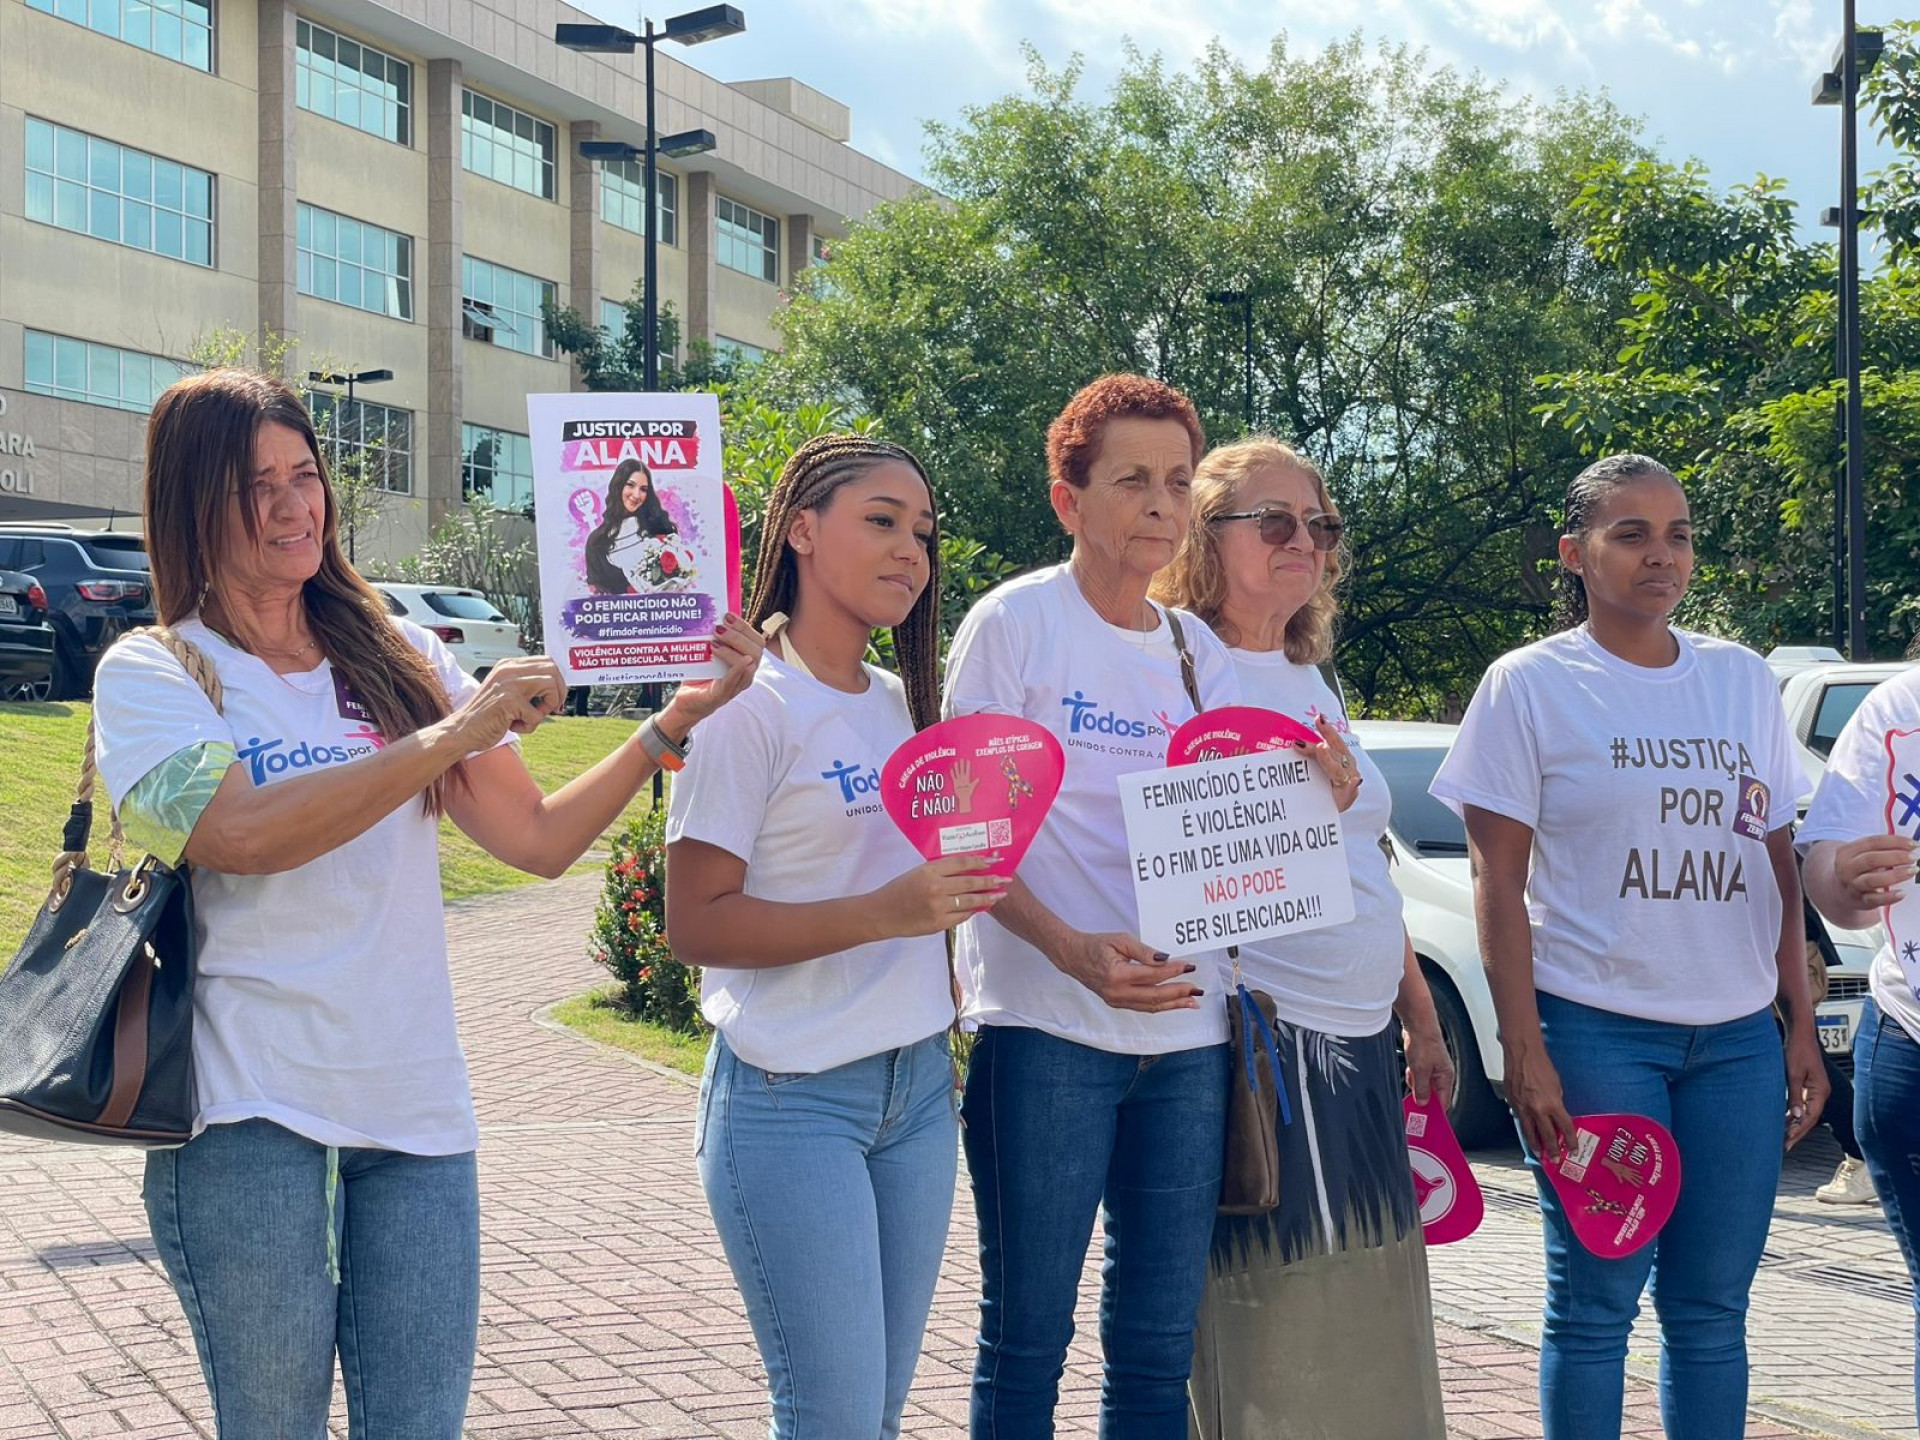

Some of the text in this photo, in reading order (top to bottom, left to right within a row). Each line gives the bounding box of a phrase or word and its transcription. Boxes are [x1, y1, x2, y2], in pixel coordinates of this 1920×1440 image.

[573, 421, 684, 439] JUSTIÇA POR
[575, 440, 687, 466] ALANA
[575, 609, 702, 625] PODE FICAR IMPUNE!
[582, 595, 697, 612] O FEMINICÍDIO NÃO
[574, 643, 707, 657] VIOLÊNCIA CONTRA A MULHER
[579, 657, 599, 667] NÃO
[601, 657, 619, 666] TEM
[669, 654, 688, 663] TEM
[1061, 690, 1166, 738] Todos por
[238, 737, 372, 787] Todos por
[1068, 738, 1107, 753] UNIDOS
[1109, 746, 1153, 758] CONTRA
[1609, 737, 1757, 781] #JUSTIÇA
[917, 769, 944, 793] NÃO
[1142, 759, 1310, 810] FEMINICÍDIO É CRIME!
[846, 804, 883, 817] UNIDOS
[911, 792, 955, 818] É NÃO!
[1181, 798, 1287, 838] É VIOLÊNCIA!
[1660, 786, 1725, 827] POR
[1136, 822, 1339, 882] É O FIM DE UMA VIDA QUE
[1203, 867, 1287, 905] NÃO PODE
[1618, 847, 1749, 904] ALANA
[1175, 894, 1322, 946] SER SILENCIADA!!!
